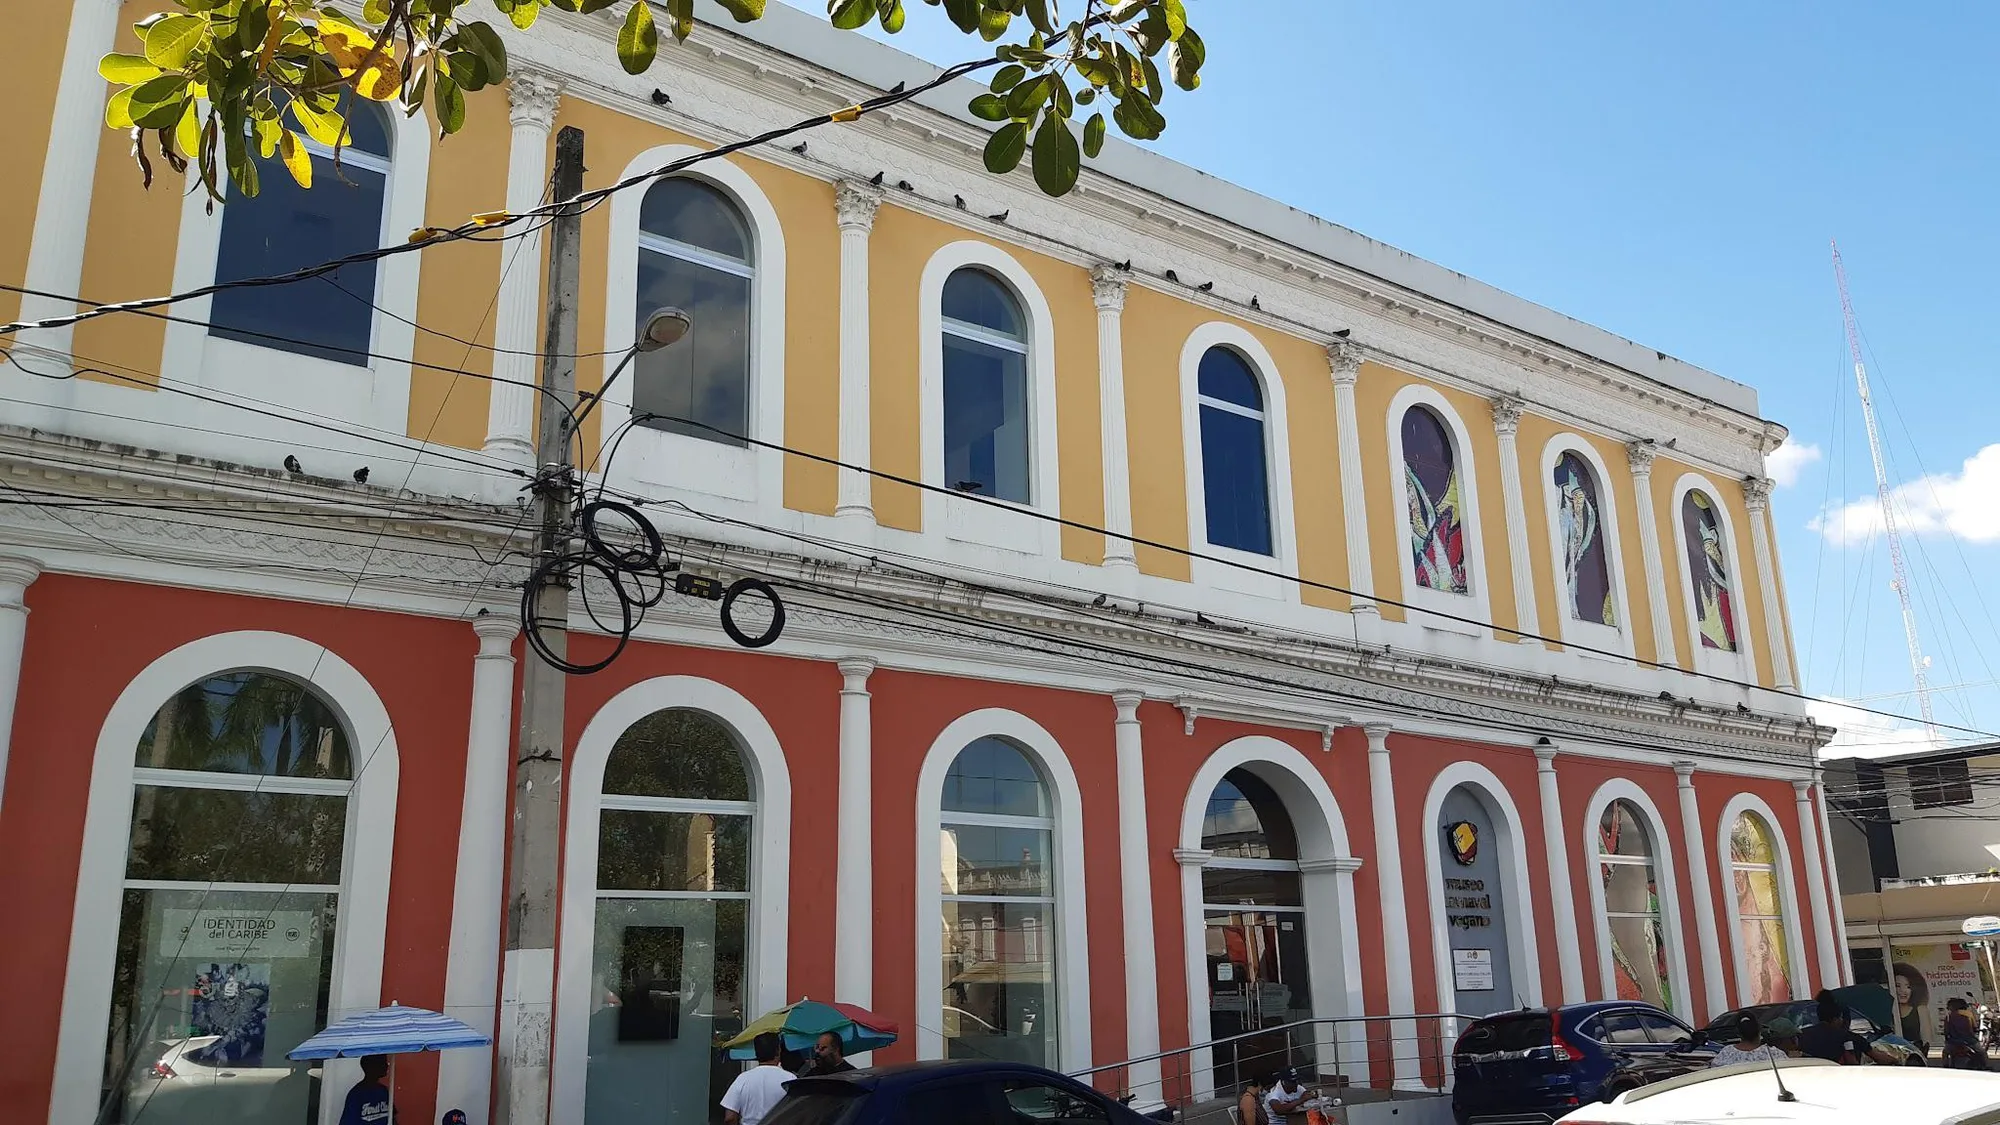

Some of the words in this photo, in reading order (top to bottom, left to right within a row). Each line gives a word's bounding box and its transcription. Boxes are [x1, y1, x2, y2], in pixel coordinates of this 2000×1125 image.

[203, 919, 276, 929] IDENTIDAD
[208, 930, 224, 939] del
[228, 930, 269, 939] CARIBE
[1925, 971, 1976, 979] hidratados
